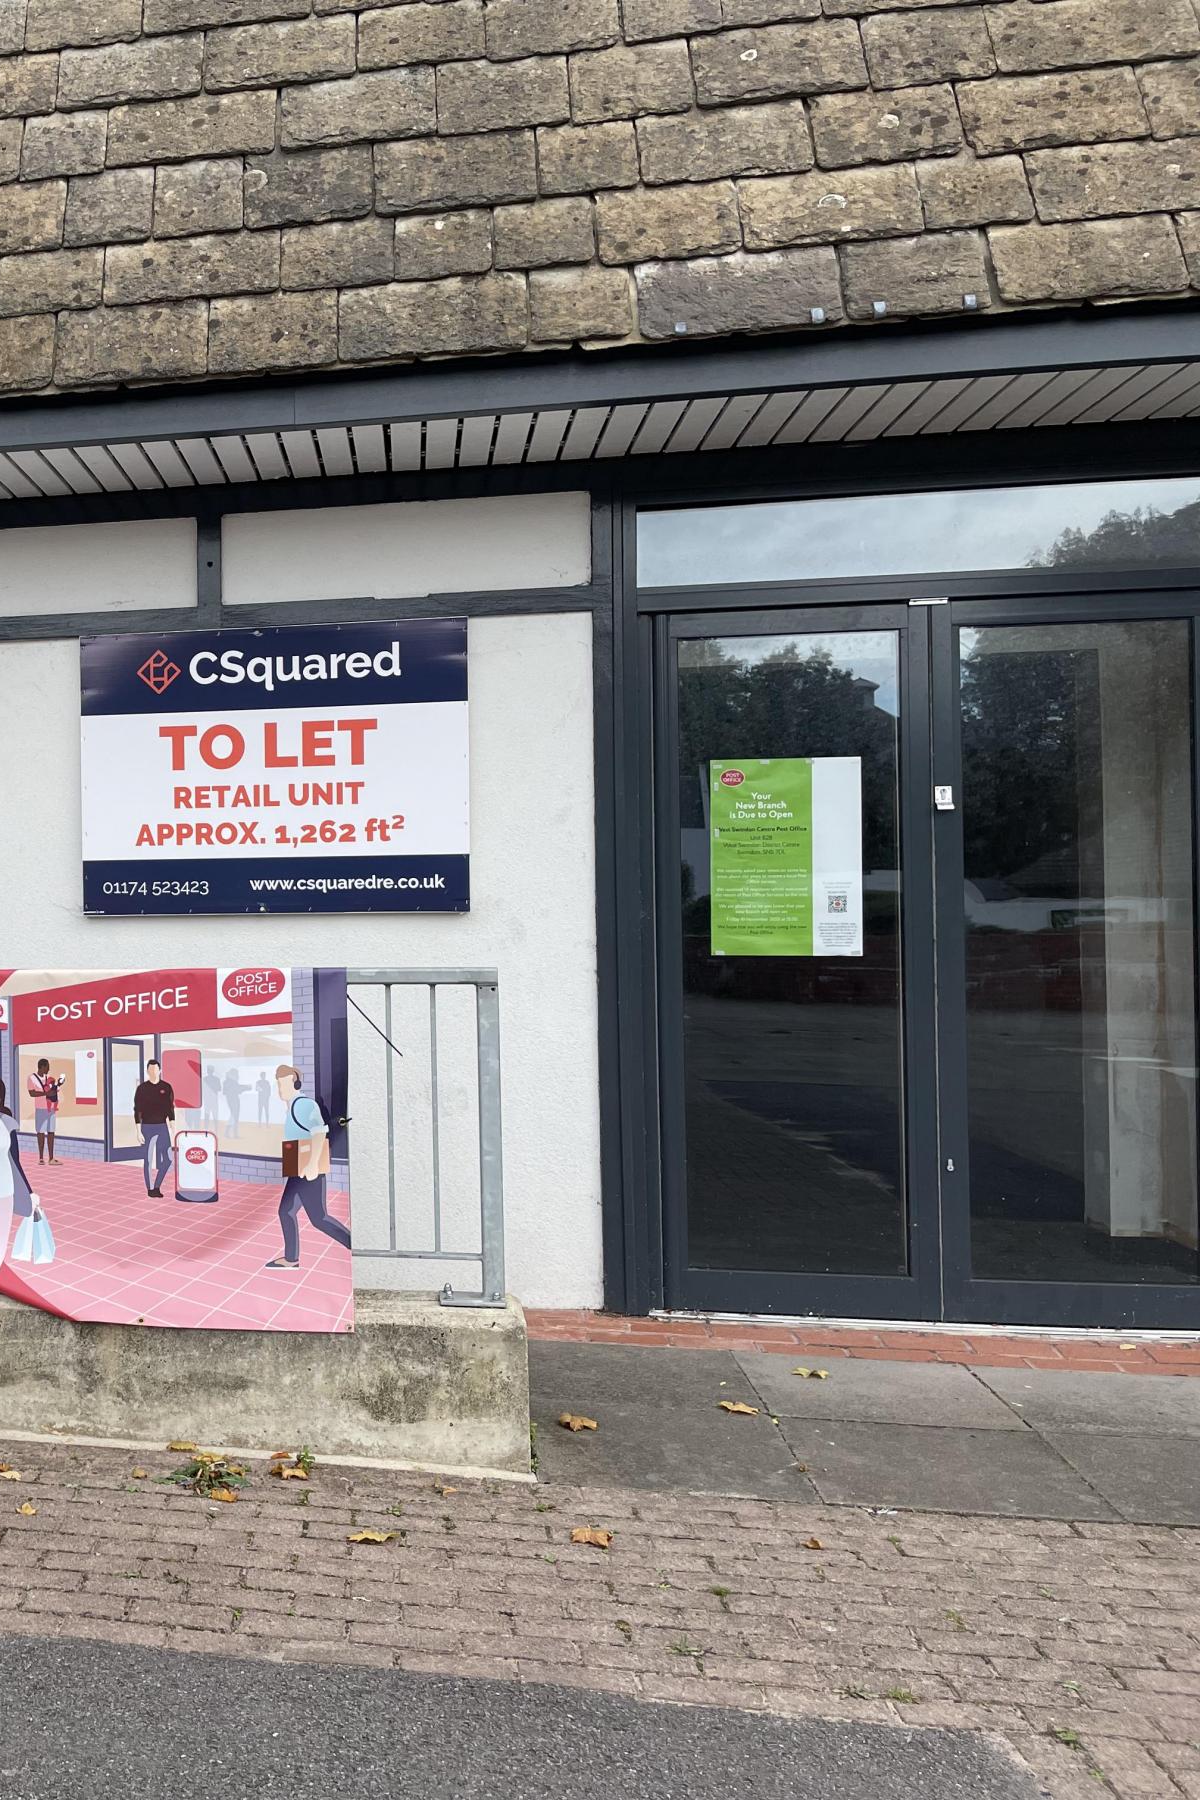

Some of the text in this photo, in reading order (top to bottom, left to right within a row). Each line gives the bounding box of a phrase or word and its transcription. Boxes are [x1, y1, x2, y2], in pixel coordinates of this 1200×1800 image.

[189, 641, 402, 691] CSquared
[159, 718, 378, 771] TO LET
[173, 781, 364, 810] RETAIL UNIT
[735, 801, 787, 810] New Branch
[751, 792, 772, 800] Your
[729, 811, 736, 819] is
[769, 810, 793, 820] Open
[135, 821, 266, 847] APPROX.
[274, 819, 356, 848] 1,262
[103, 873, 445, 897] 01174 523423 www.csquaredre.co.uk
[235, 971, 272, 985] POST
[227, 983, 277, 998] OFFICE
[37, 986, 189, 1022] POST OFFICE
